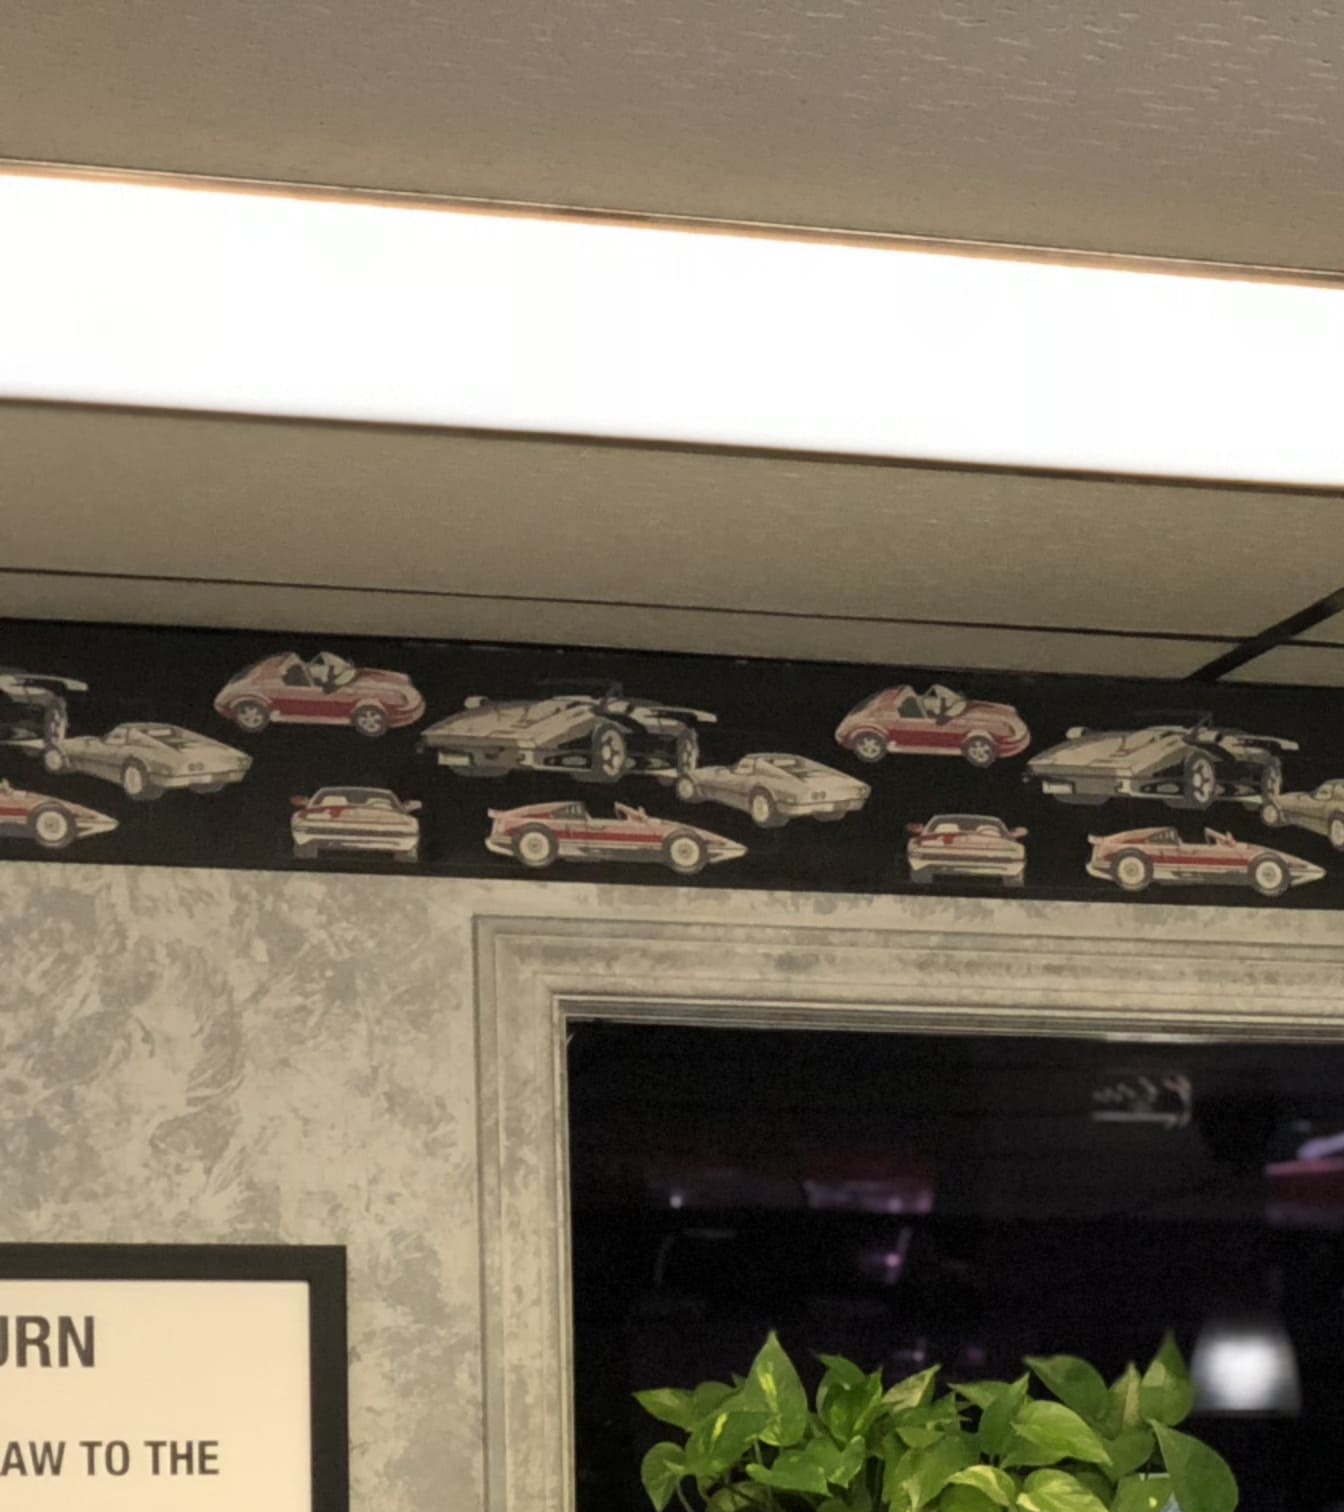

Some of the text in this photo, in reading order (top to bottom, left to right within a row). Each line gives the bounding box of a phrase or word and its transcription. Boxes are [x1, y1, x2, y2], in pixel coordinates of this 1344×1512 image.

[0, 1315, 95, 1368] RN
[79, 1440, 131, 1476] TO
[144, 1440, 219, 1476] THE
